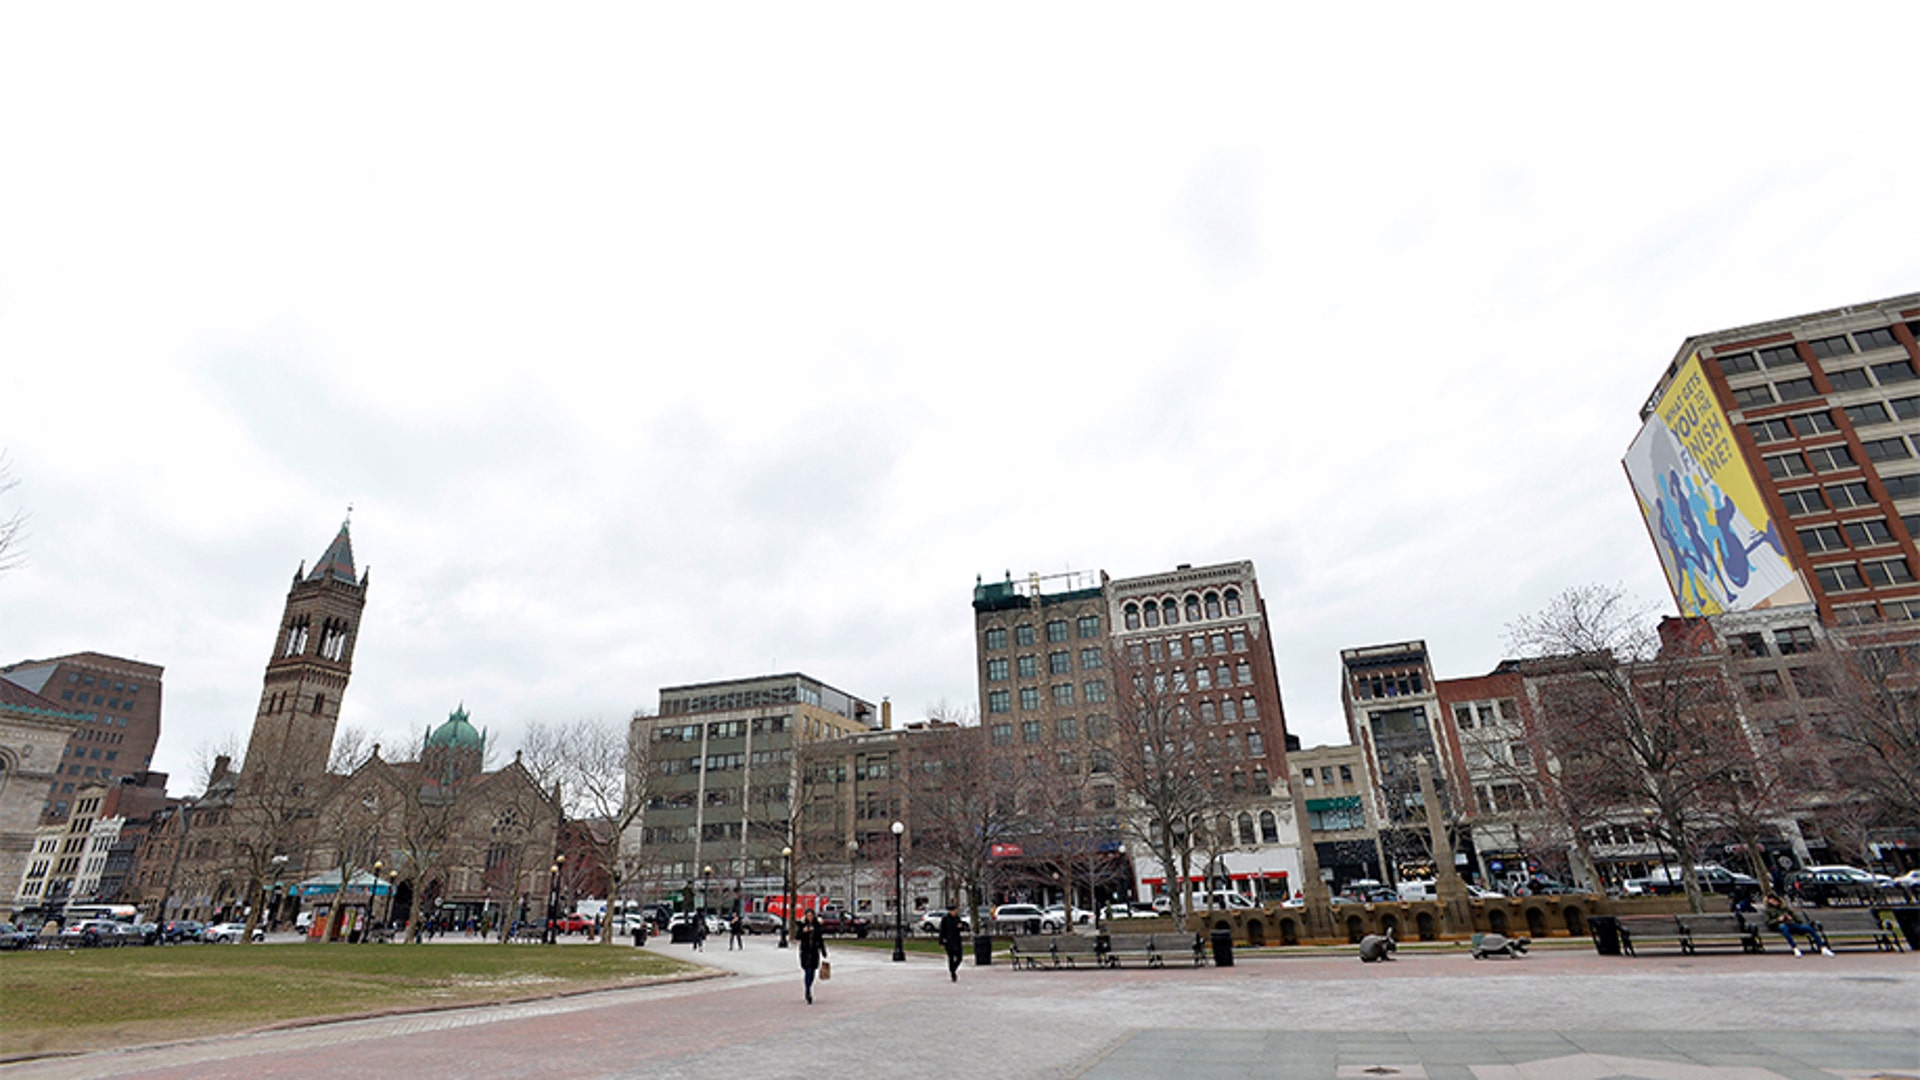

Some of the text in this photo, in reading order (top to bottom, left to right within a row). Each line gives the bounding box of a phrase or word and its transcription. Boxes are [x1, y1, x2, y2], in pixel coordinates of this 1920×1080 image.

[1665, 372, 1701, 422] WHAT GETS
[1671, 402, 1699, 446] YOU
[1680, 412, 1723, 472] FINISH
[1697, 437, 1733, 485] LINE?
